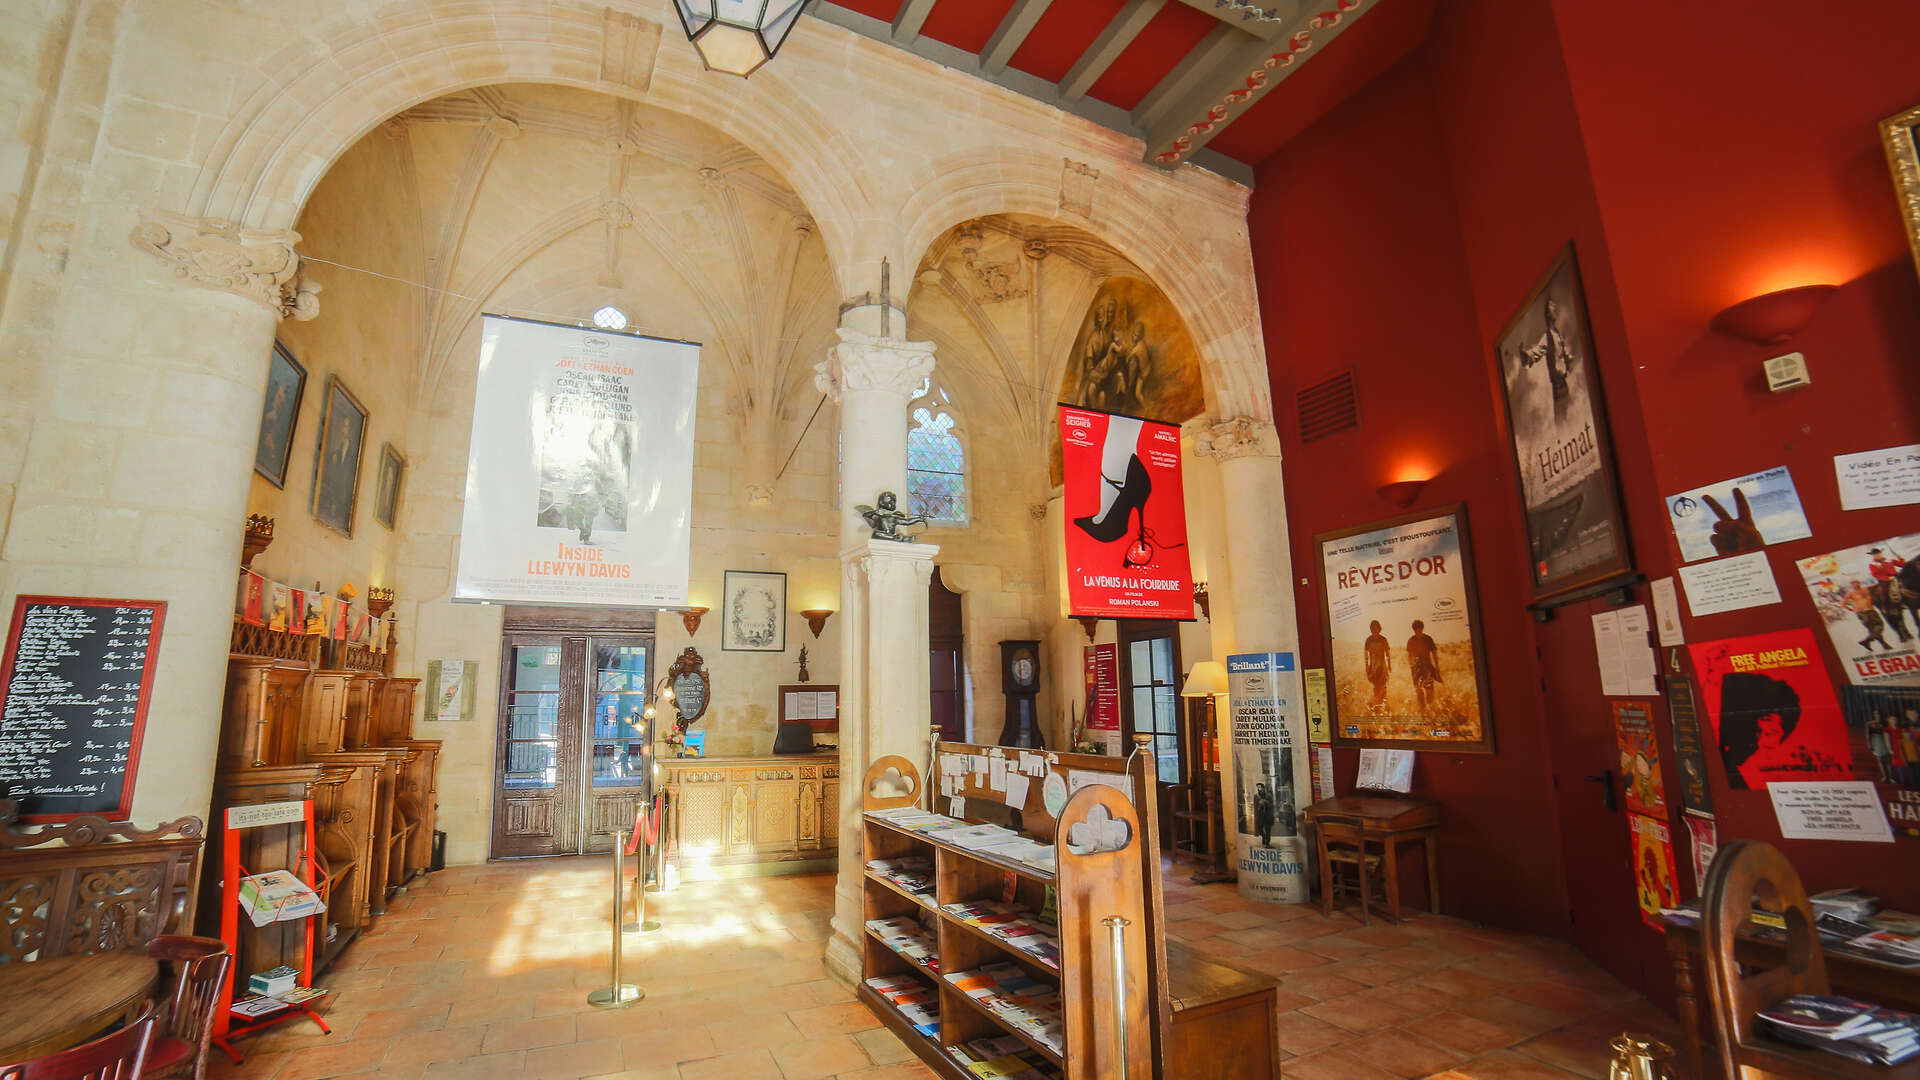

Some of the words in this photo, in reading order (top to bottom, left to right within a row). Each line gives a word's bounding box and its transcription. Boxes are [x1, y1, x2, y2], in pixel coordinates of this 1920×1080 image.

[1538, 421, 1594, 484] Heimat
[528, 560, 586, 577] LLEWYN
[589, 563, 631, 579] DAVIS
[1337, 563, 1395, 590] RÊVES
[1398, 554, 1447, 580] D'OR
[1083, 576, 1095, 587] LA
[1129, 579, 1139, 589] LA
[1140, 579, 1180, 591] FOURRURE
[1109, 598, 1131, 606] ROMAN
[1131, 599, 1160, 607] POLANSKI
[1671, 648, 1681, 673] 4
[1730, 654, 1755, 666] FREE
[1759, 647, 1808, 665] ANGELA
[1856, 660, 1880, 677] LE
[1272, 862, 1304, 875] DAVIS
